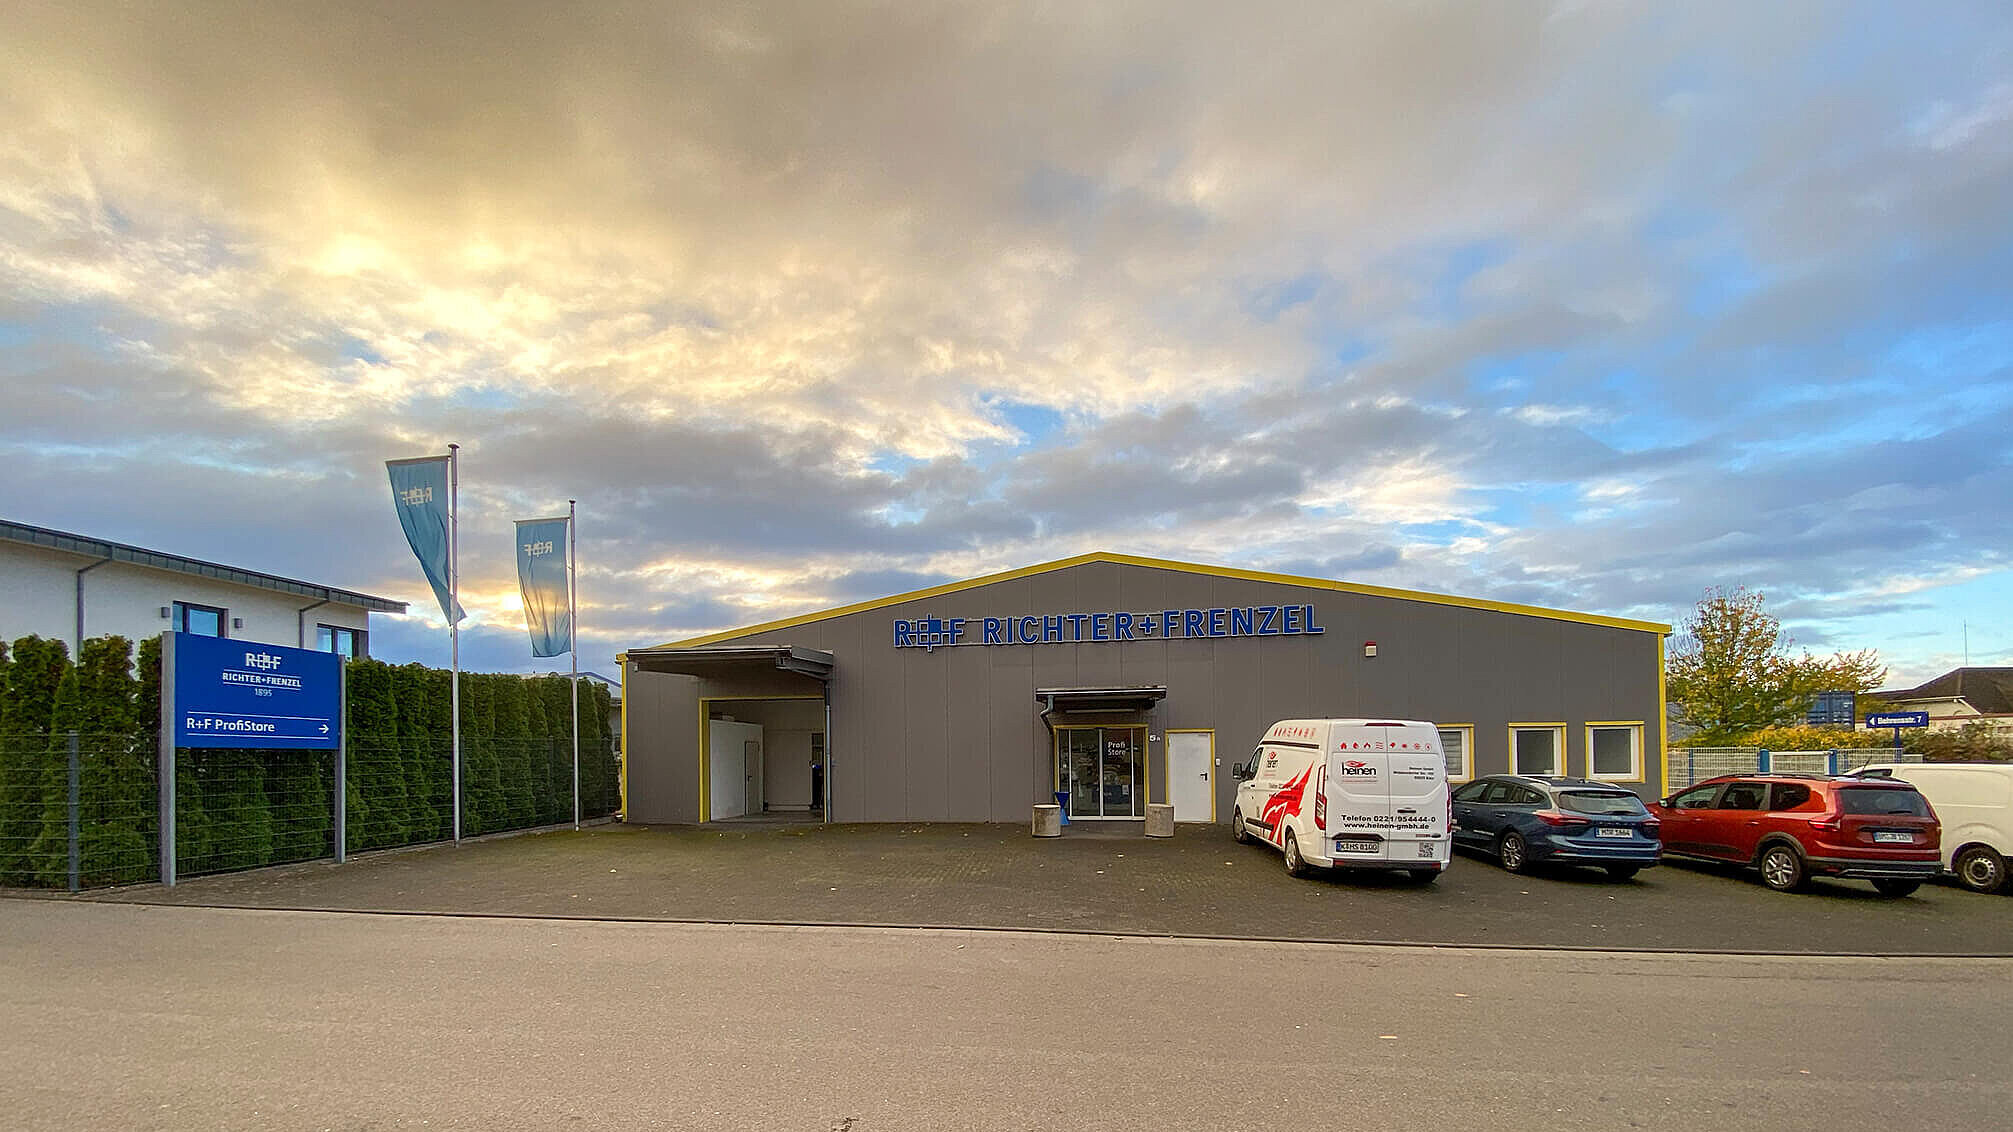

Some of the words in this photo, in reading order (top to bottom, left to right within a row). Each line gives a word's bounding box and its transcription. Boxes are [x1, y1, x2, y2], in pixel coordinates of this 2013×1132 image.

[983, 605, 1325, 645] RICHTER+FRENZEL
[222, 672, 302, 687] RICHTER+FRENZEL
[255, 688, 273, 697] 1895
[186, 717, 212, 730] R+F
[215, 720, 276, 732] ProfiStore
[1107, 741, 1126, 749] Profi
[1341, 761, 1377, 775] heinen
[1341, 814, 1372, 822] Telefon
[1343, 822, 1430, 830] www.heinen-gmbh.de
